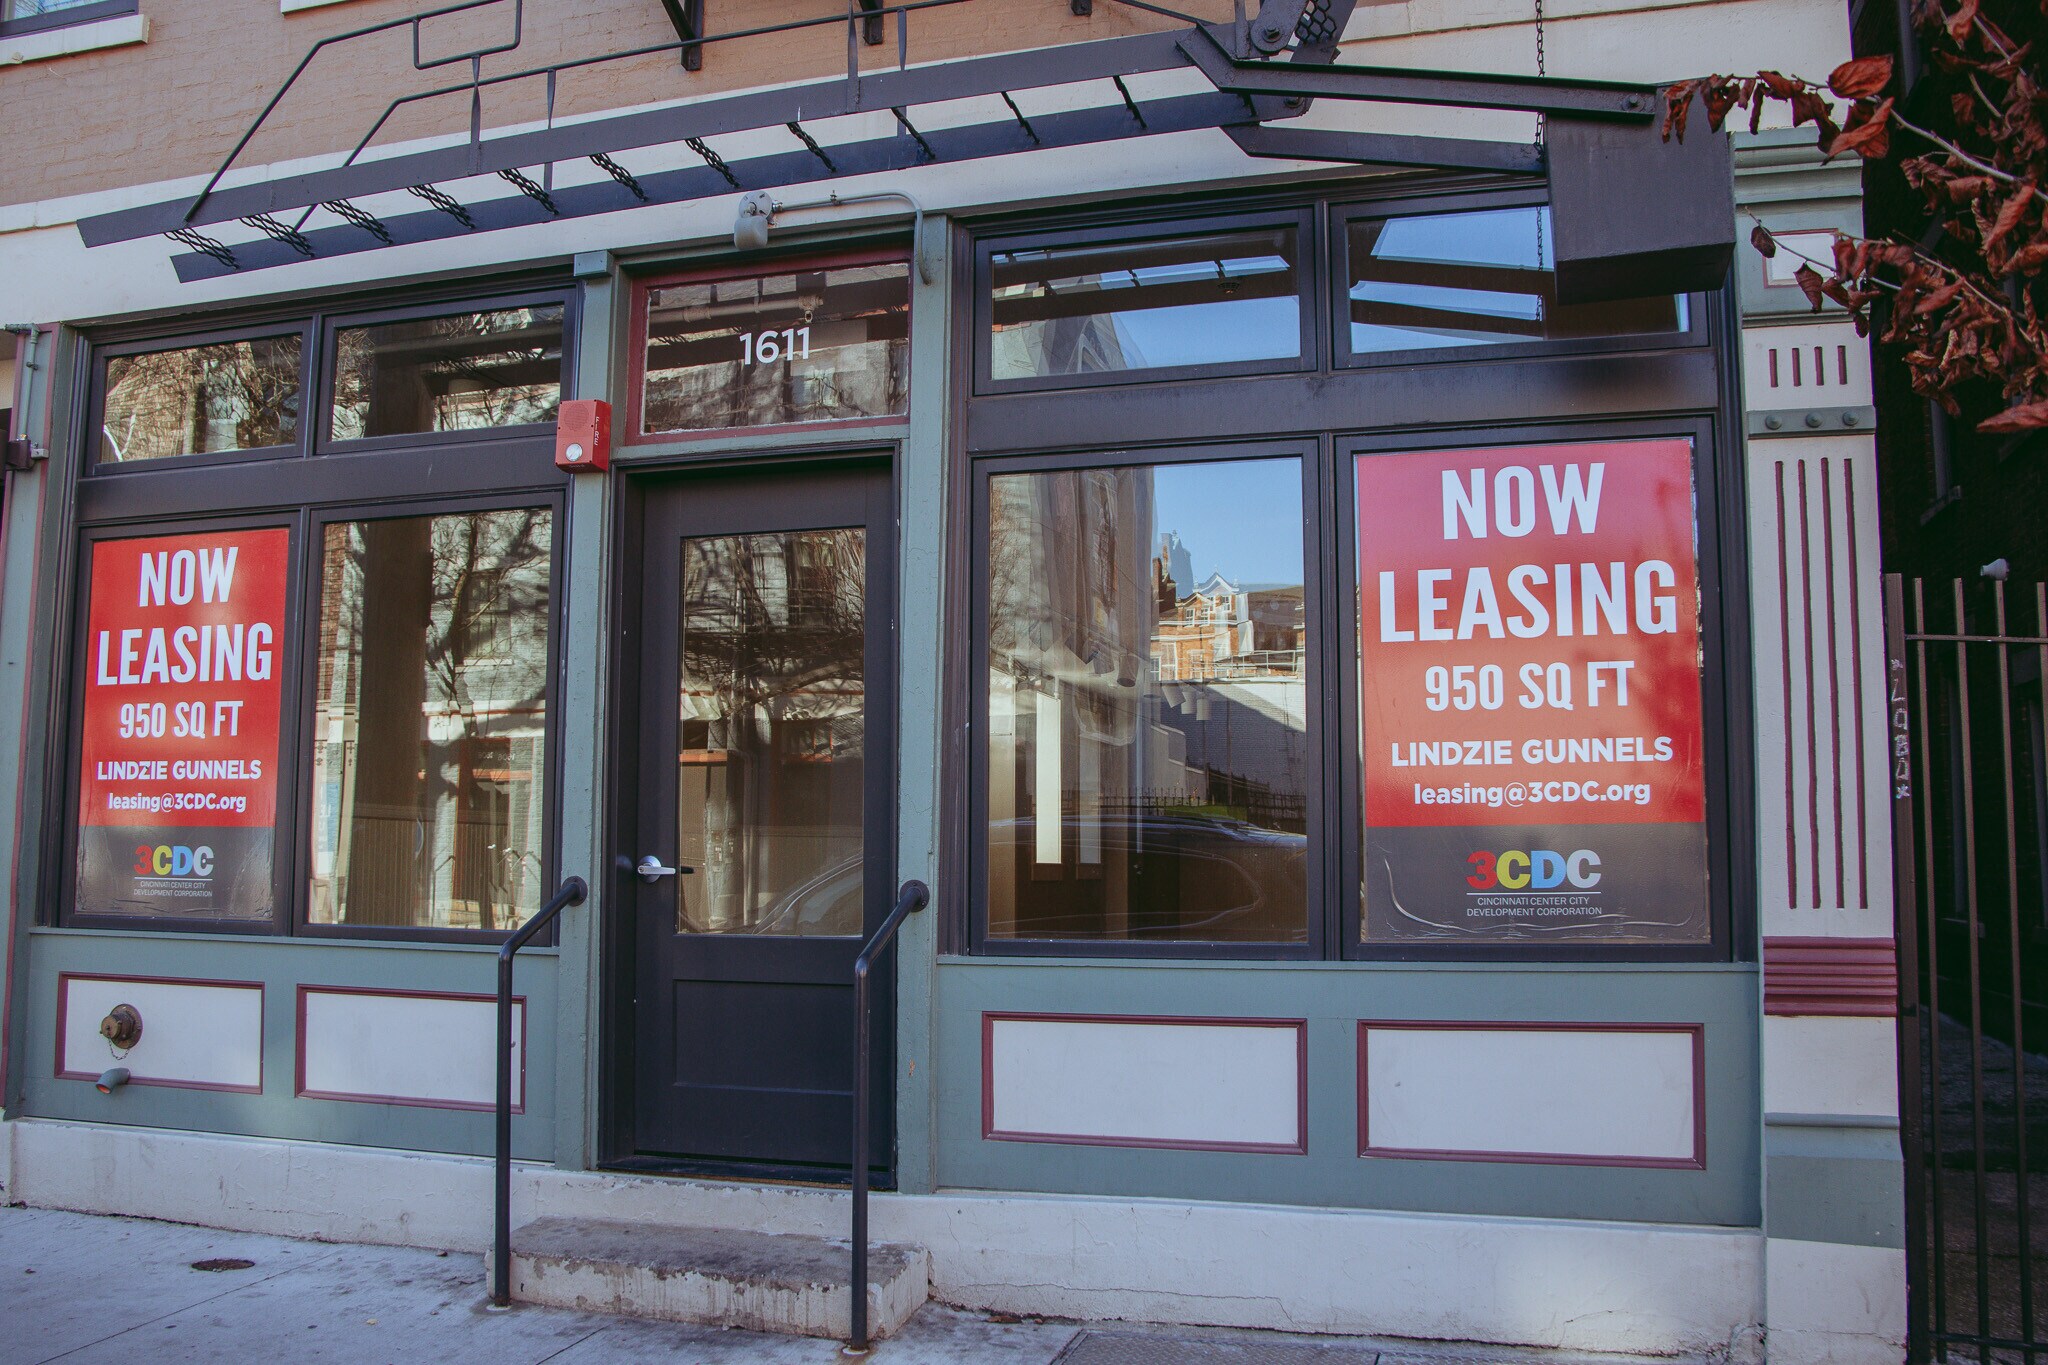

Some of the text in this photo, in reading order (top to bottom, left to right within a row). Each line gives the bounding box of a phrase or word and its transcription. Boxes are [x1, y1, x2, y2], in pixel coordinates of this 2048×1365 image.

[740, 327, 809, 365] 1611
[1442, 463, 1605, 539] NOW
[139, 547, 238, 607] NOW
[1379, 560, 1677, 642] LEASING
[97, 622, 273, 685] LEASING
[1425, 661, 1635, 711] 950 SQ FT
[119, 700, 244, 739] 950 SQ FT
[1391, 736, 1674, 767] LINDZIE GUNNELS
[97, 760, 262, 780] LINDZIE GUNNELS
[108, 792, 246, 813] leasing@3CDC.org
[1414, 781, 1650, 807] leasing@3CDC.org
[134, 845, 214, 876] 3CDC
[1466, 849, 1601, 889] 3CDC
[174, 889, 212, 897] CORPORATION
[1477, 896, 1590, 906] CINCINNATI CENTER CITY
[1467, 907, 1602, 917] DEVELOPMENT CORPORATION
